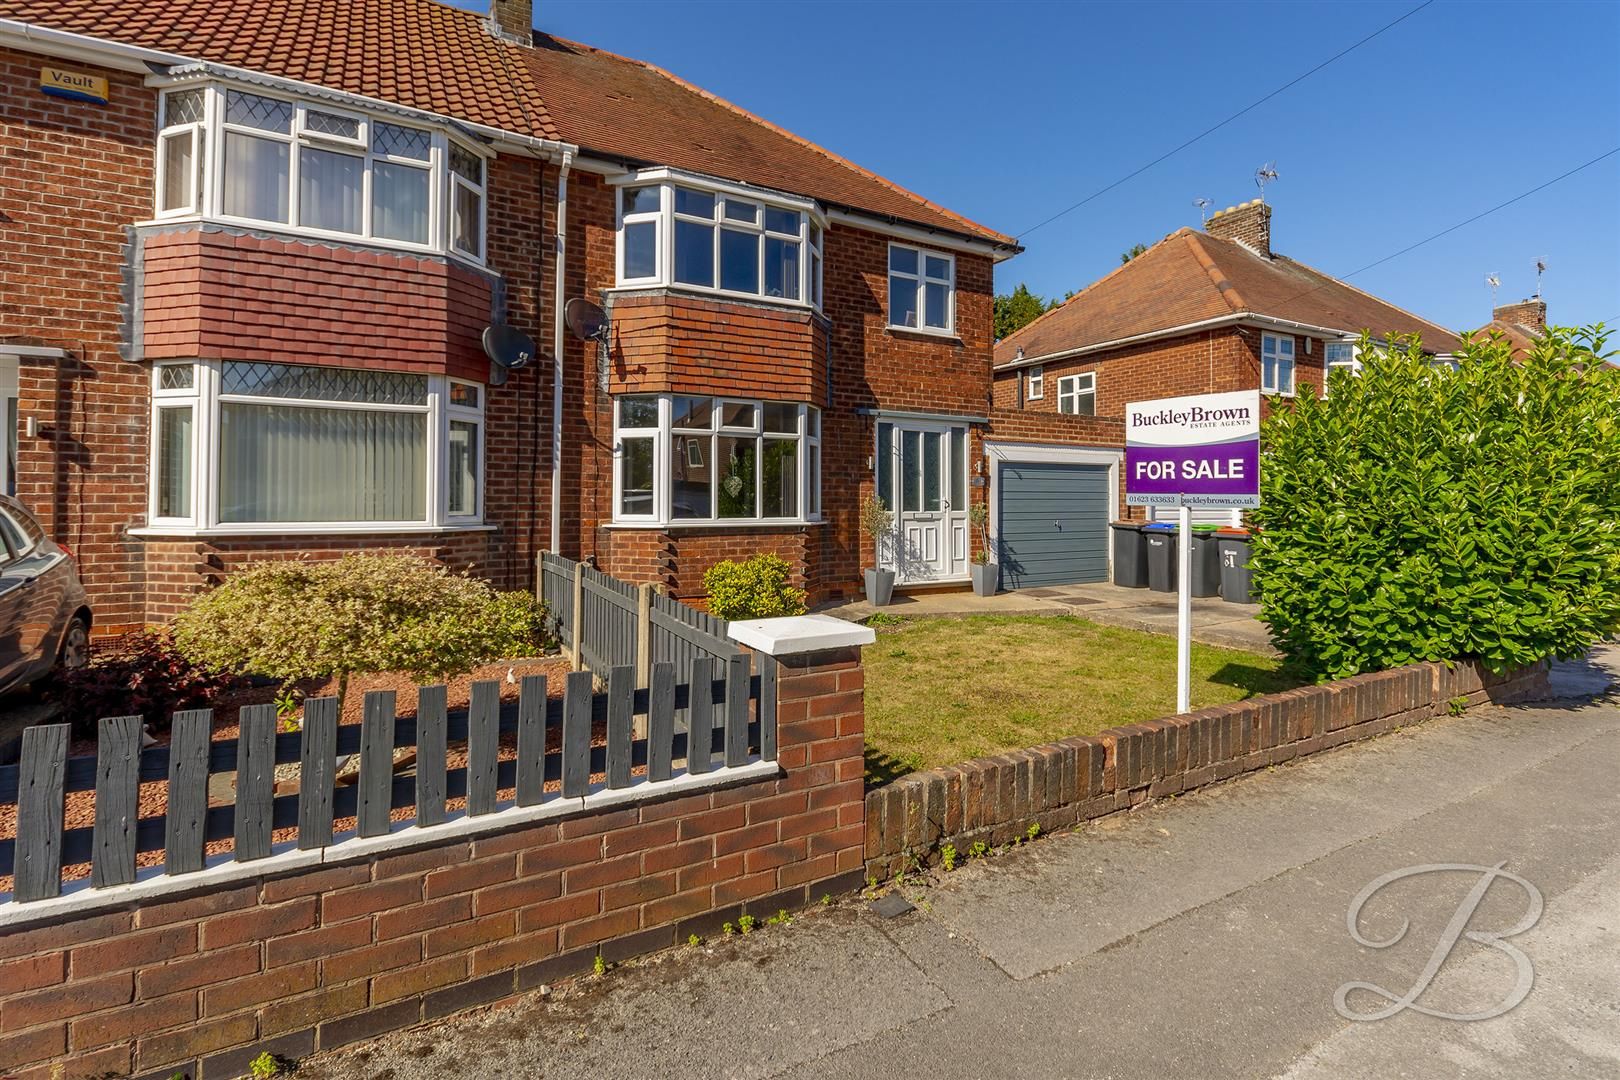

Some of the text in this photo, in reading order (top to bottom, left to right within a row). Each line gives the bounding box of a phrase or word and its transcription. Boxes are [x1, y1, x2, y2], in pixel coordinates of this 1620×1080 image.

[51, 71, 95, 88] Vault
[1132, 407, 1250, 427] BuckleyBrown
[1136, 458, 1244, 480] FOR SALE
[1180, 495, 1255, 505] buckleybrown.co.uk
